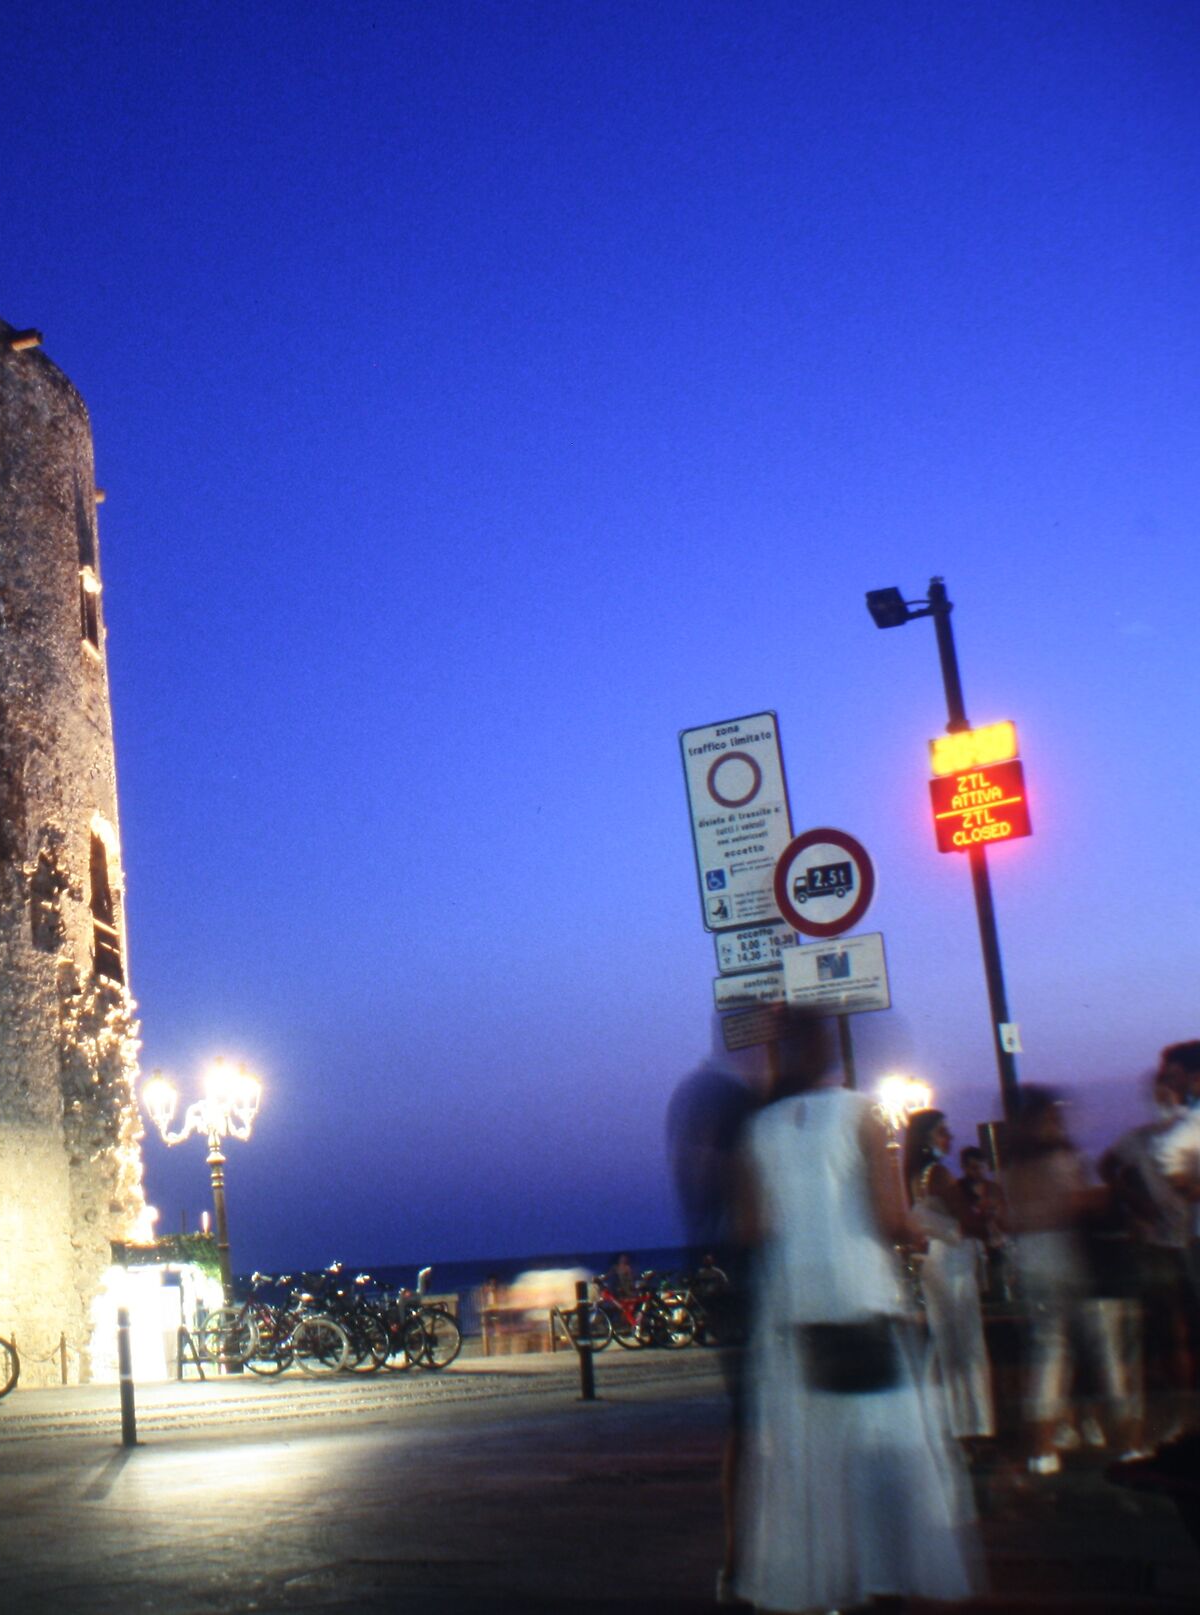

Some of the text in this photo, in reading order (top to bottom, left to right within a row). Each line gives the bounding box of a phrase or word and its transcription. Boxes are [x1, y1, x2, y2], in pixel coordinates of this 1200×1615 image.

[716, 725, 739, 736] zona
[688, 731, 771, 756] traffico limitato
[956, 772, 991, 793] ZTL
[951, 786, 1003, 809] ATTIVA
[961, 808, 996, 828] ZTL
[952, 821, 1011, 846] CLOSED
[724, 845, 765, 858] eccetto
[736, 928, 774, 940] eccetto
